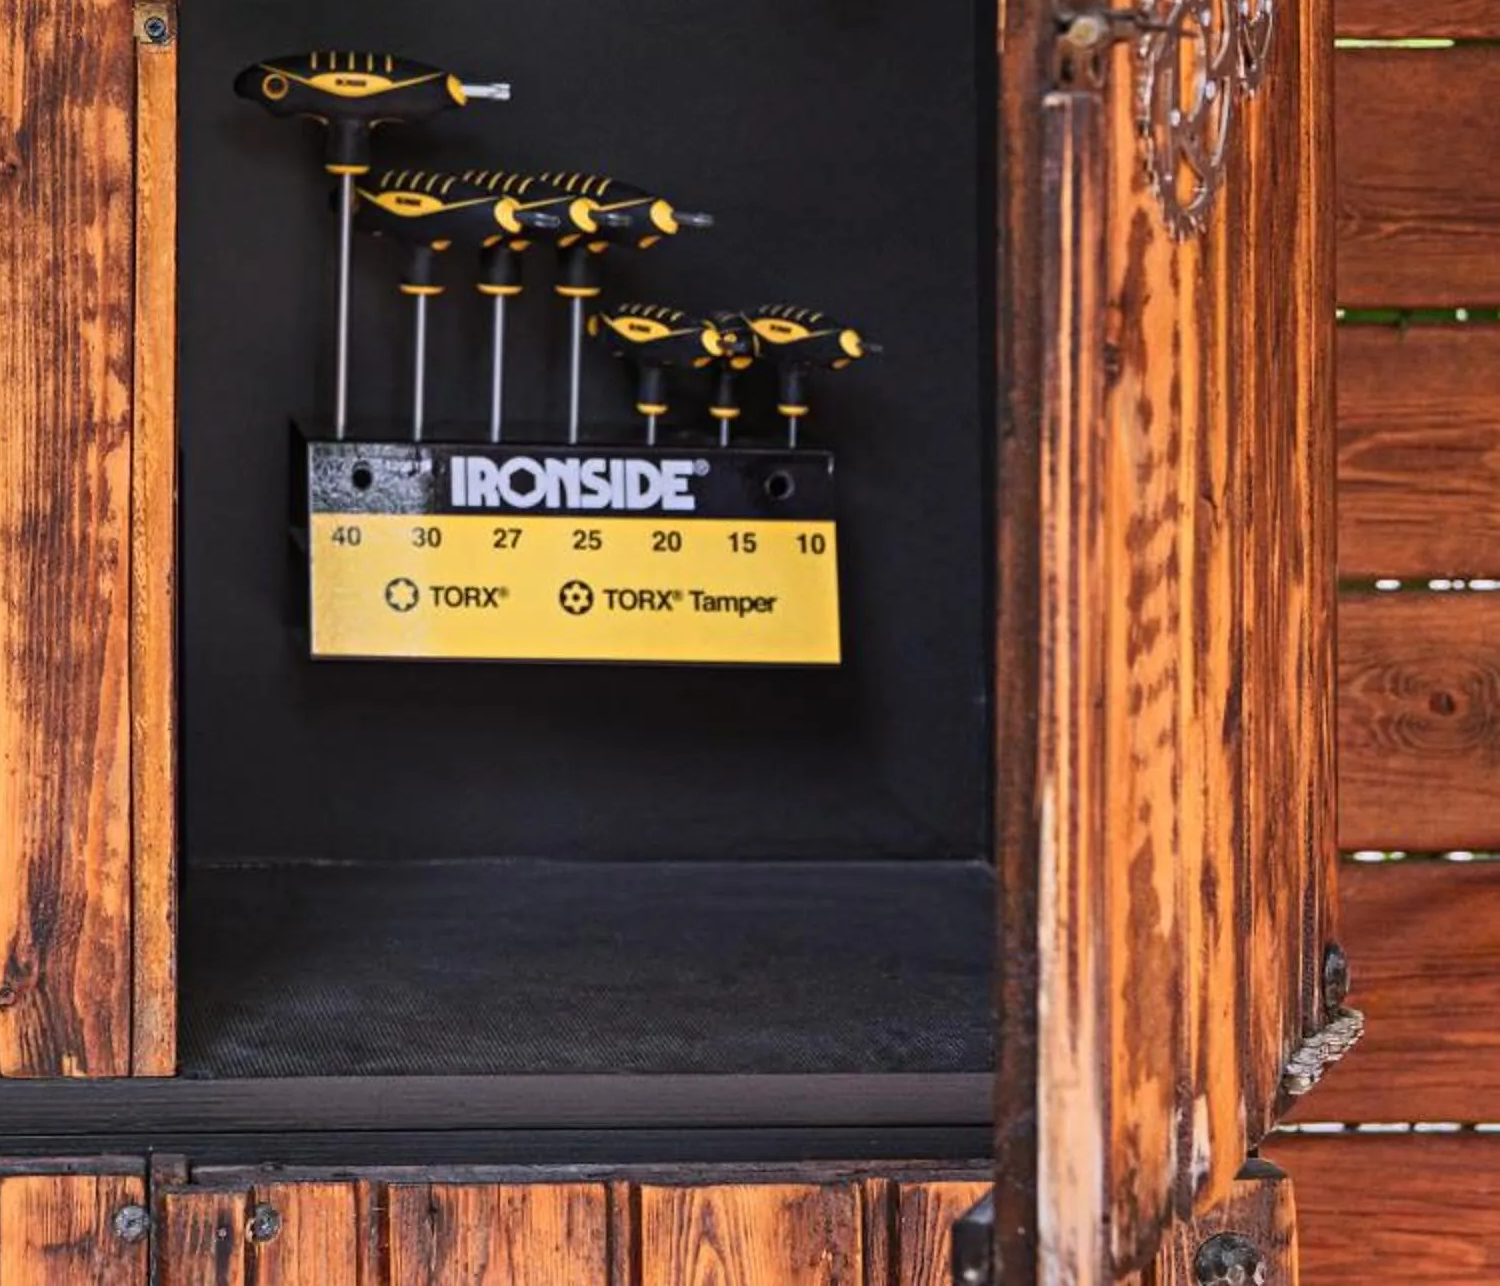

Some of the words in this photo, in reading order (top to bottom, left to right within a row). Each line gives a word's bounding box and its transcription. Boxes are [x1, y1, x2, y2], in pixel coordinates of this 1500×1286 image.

[331, 526, 362, 547] 40
[411, 526, 442, 548] 30
[492, 527, 523, 549] 27
[572, 529, 603, 551] 25
[651, 530, 683, 552] 20
[728, 532, 758, 554] 15
[797, 533, 827, 555] 10
[689, 590, 778, 618] Tamper
